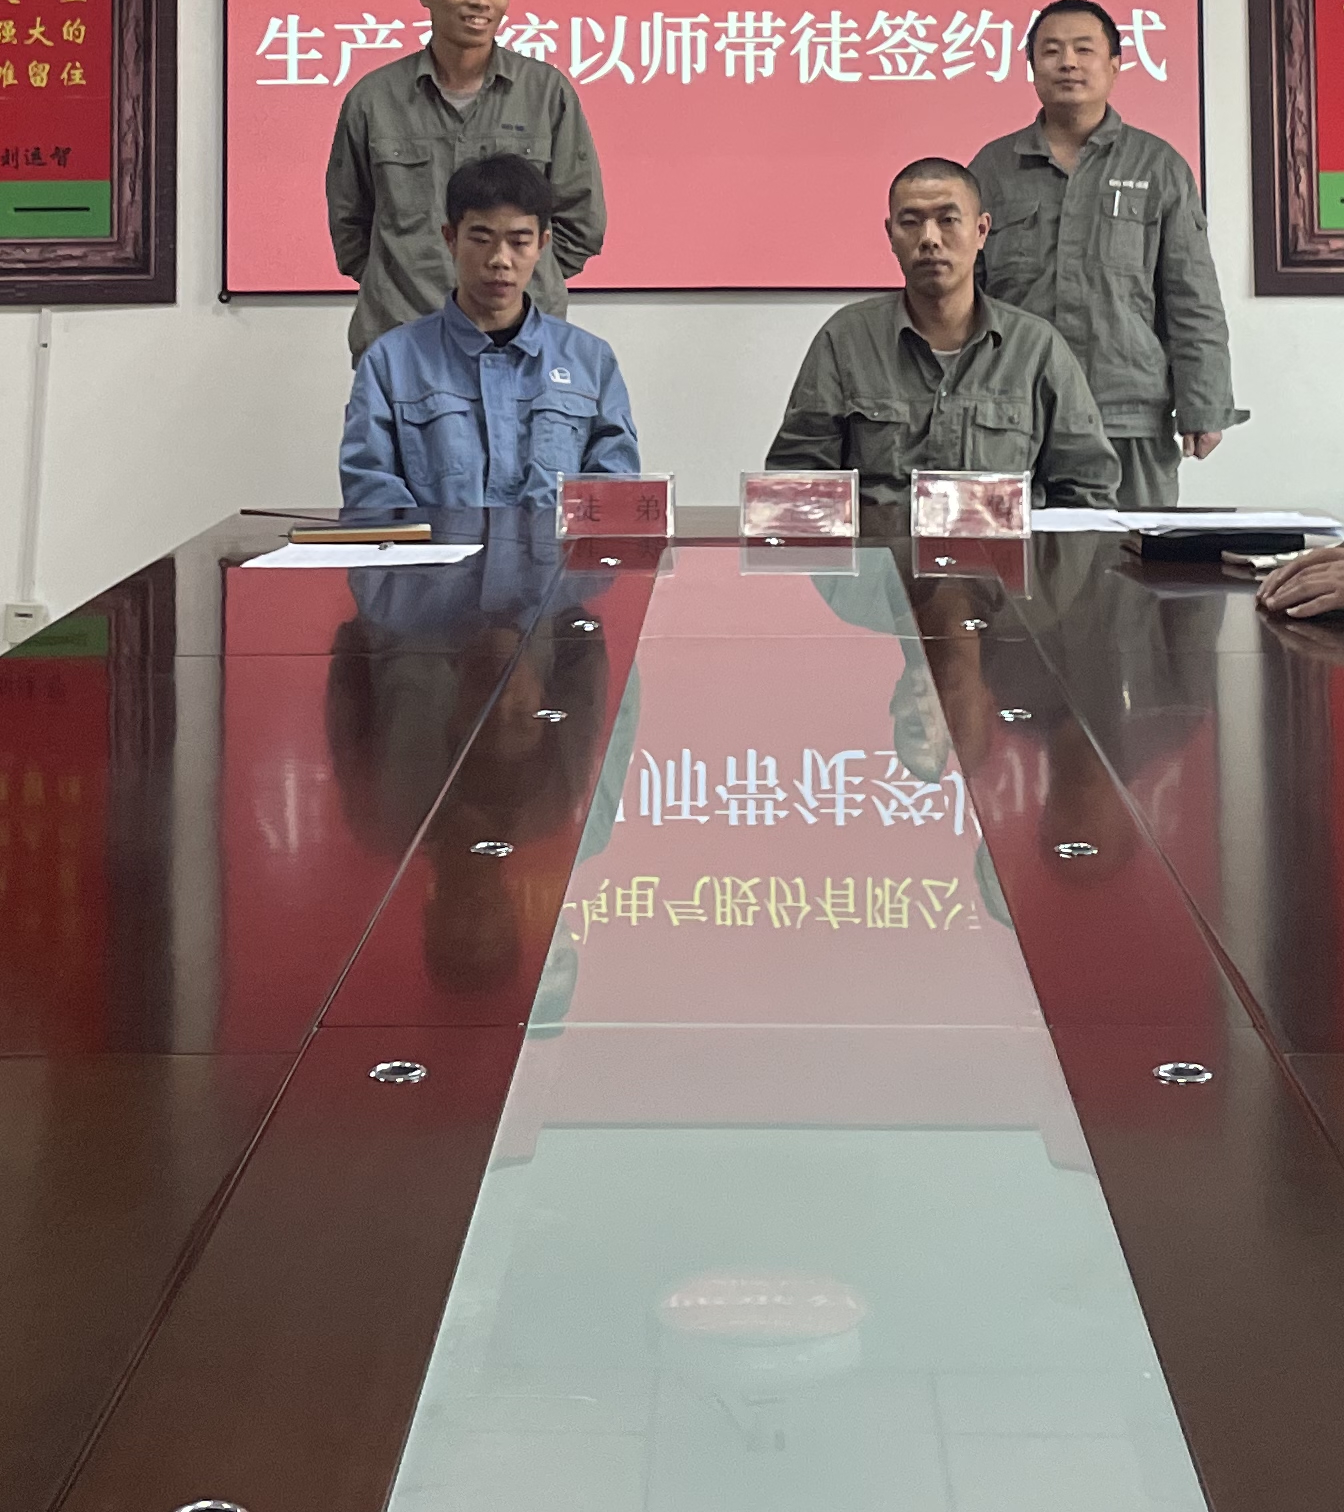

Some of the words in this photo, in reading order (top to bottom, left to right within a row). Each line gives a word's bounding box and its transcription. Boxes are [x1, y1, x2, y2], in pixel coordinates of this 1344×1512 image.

[255, 8, 1169, 87] 生产统以师带徒签约式
